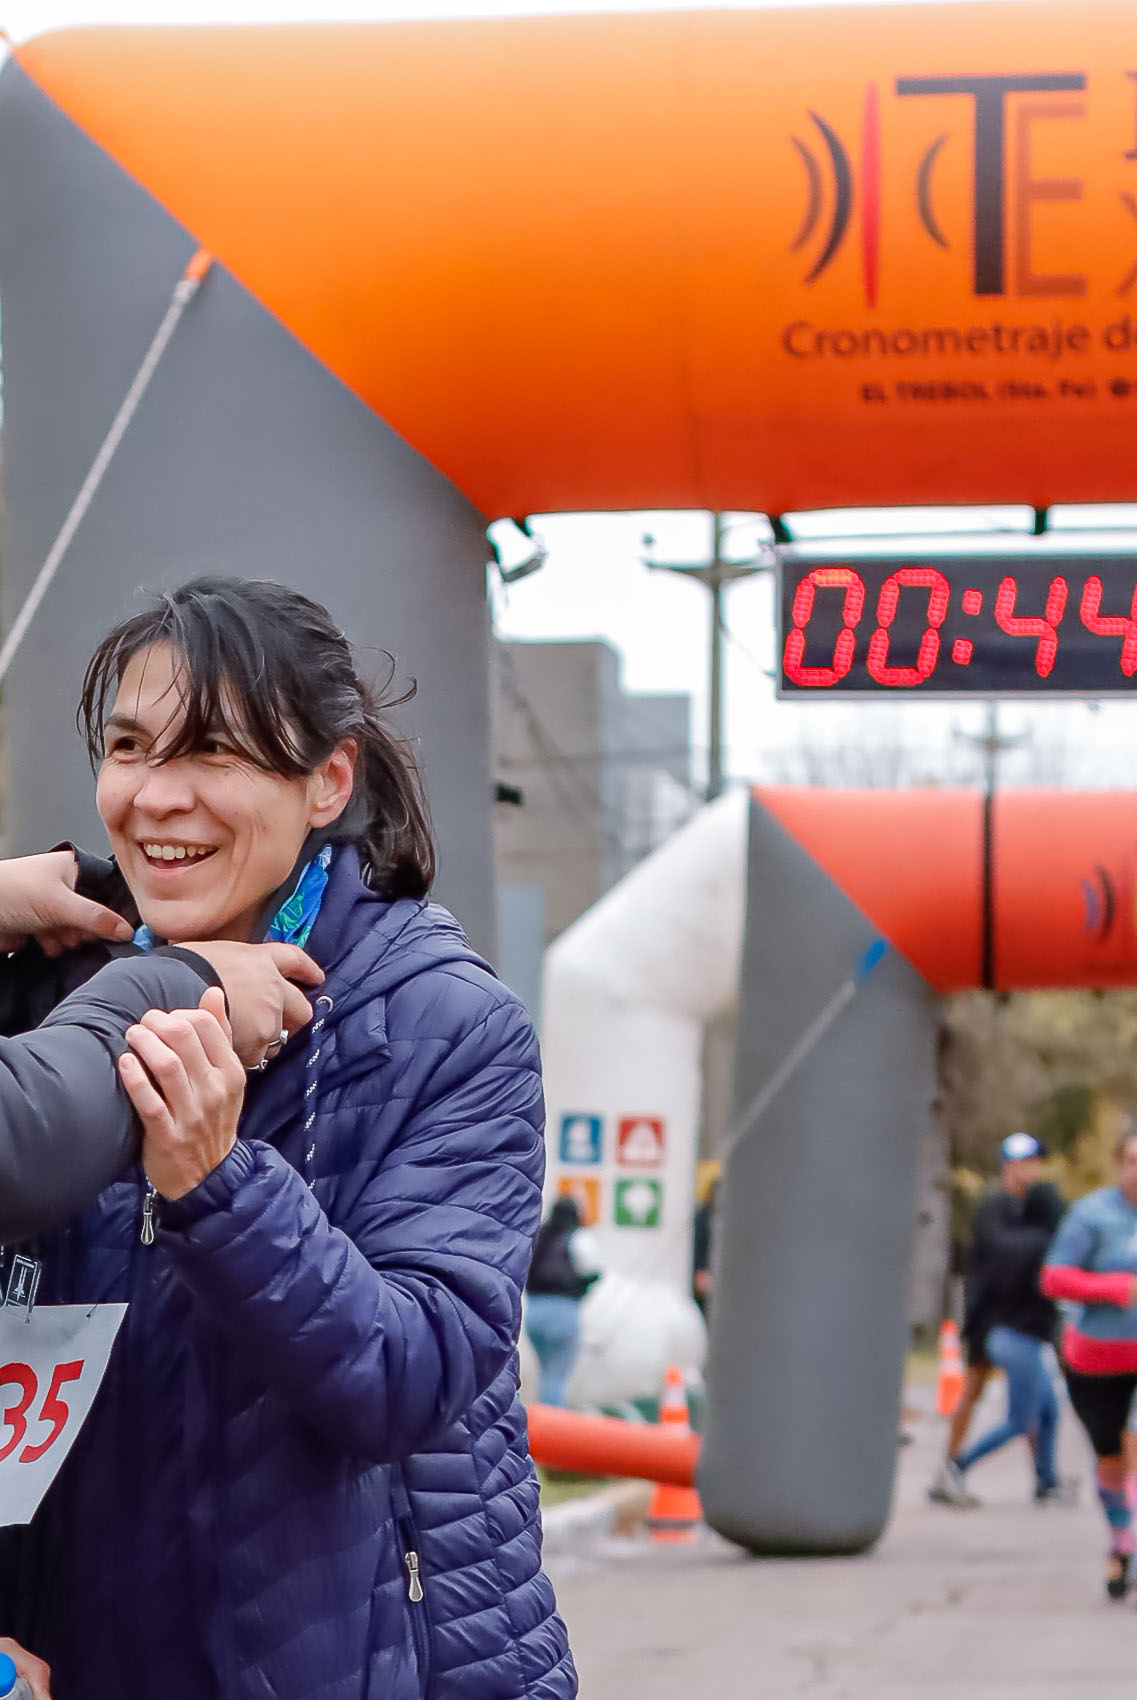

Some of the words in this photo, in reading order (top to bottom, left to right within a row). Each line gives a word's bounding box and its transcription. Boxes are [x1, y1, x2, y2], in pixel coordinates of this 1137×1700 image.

[782, 319, 1091, 362] Cronometraje
[1104, 313, 1137, 352] d
[783, 567, 1137, 686] 00:44
